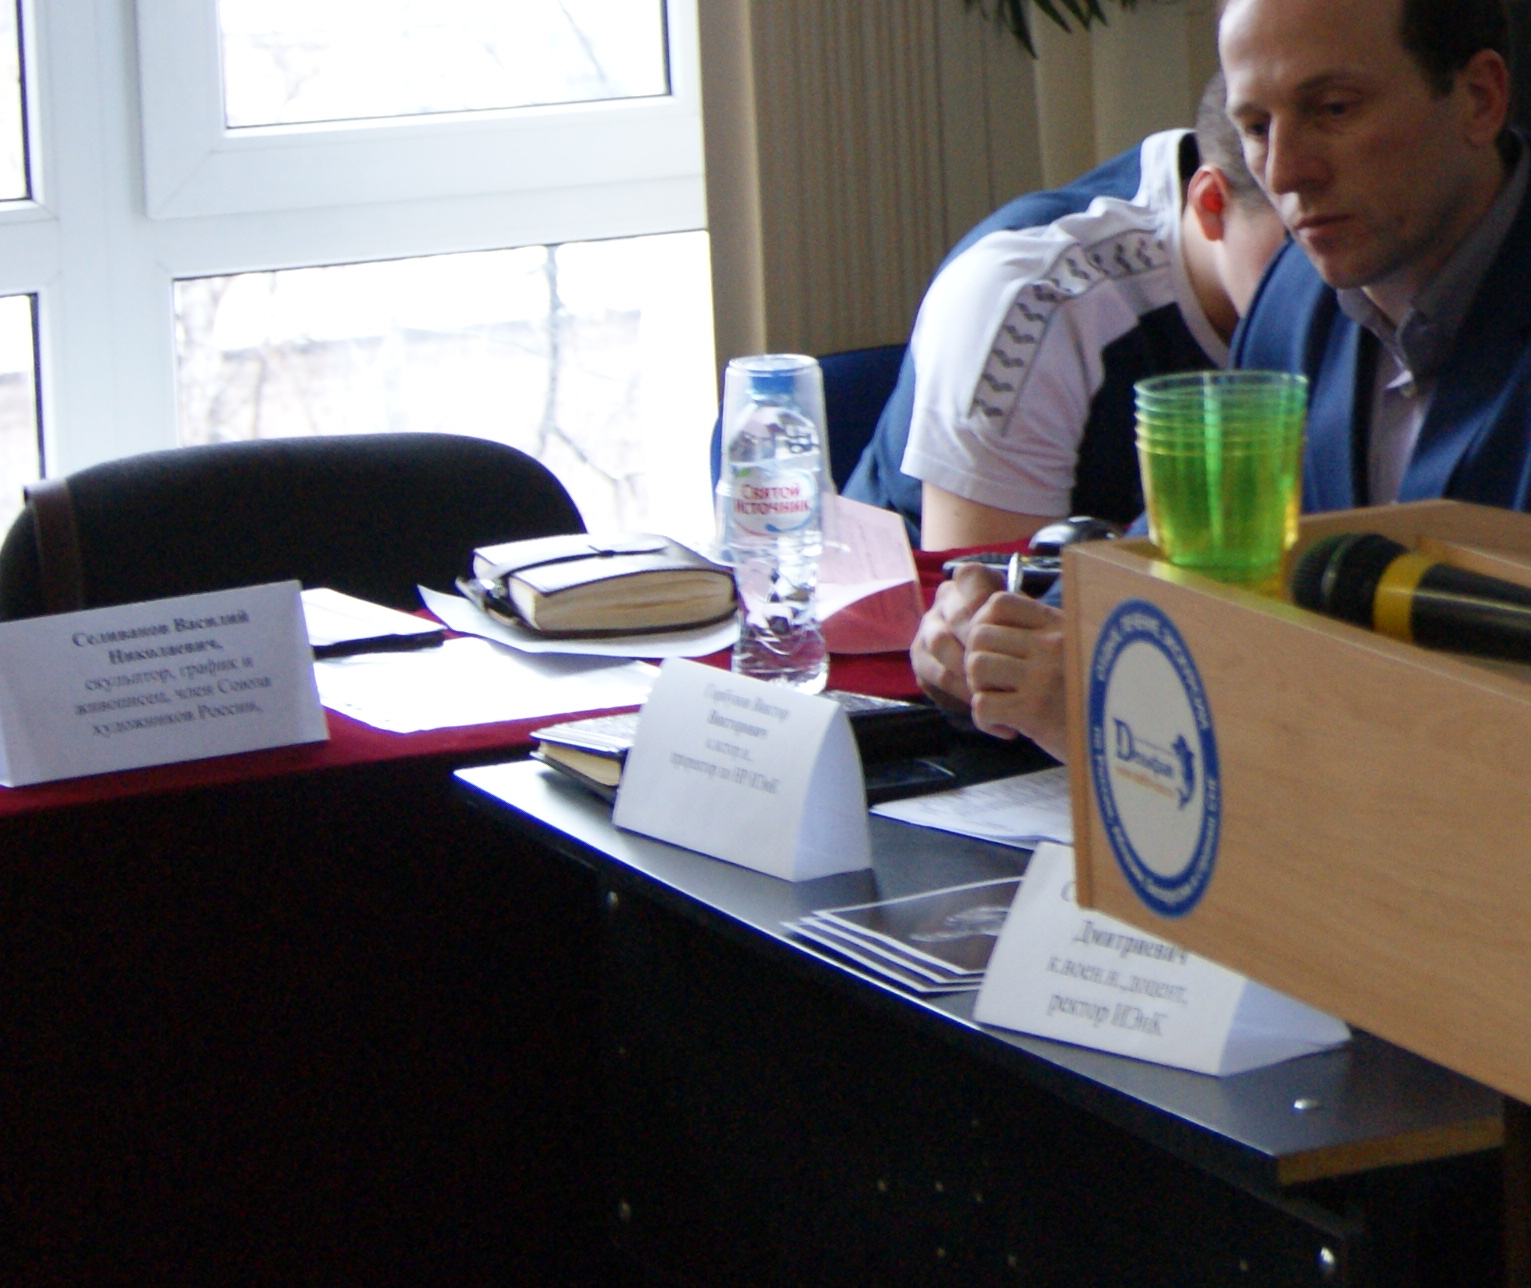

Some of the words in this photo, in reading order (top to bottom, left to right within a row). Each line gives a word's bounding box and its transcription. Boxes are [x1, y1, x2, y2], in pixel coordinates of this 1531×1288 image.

[71, 623, 169, 647] Селиванов
[173, 609, 250, 633] Василий
[179, 658, 237, 684] график
[241, 656, 254, 669] и
[174, 683, 213, 701] член
[217, 675, 273, 695] Союза
[93, 709, 194, 738] художников
[1072, 919, 1188, 965] Дмитриевич
[1047, 994, 1110, 1028] ректор
